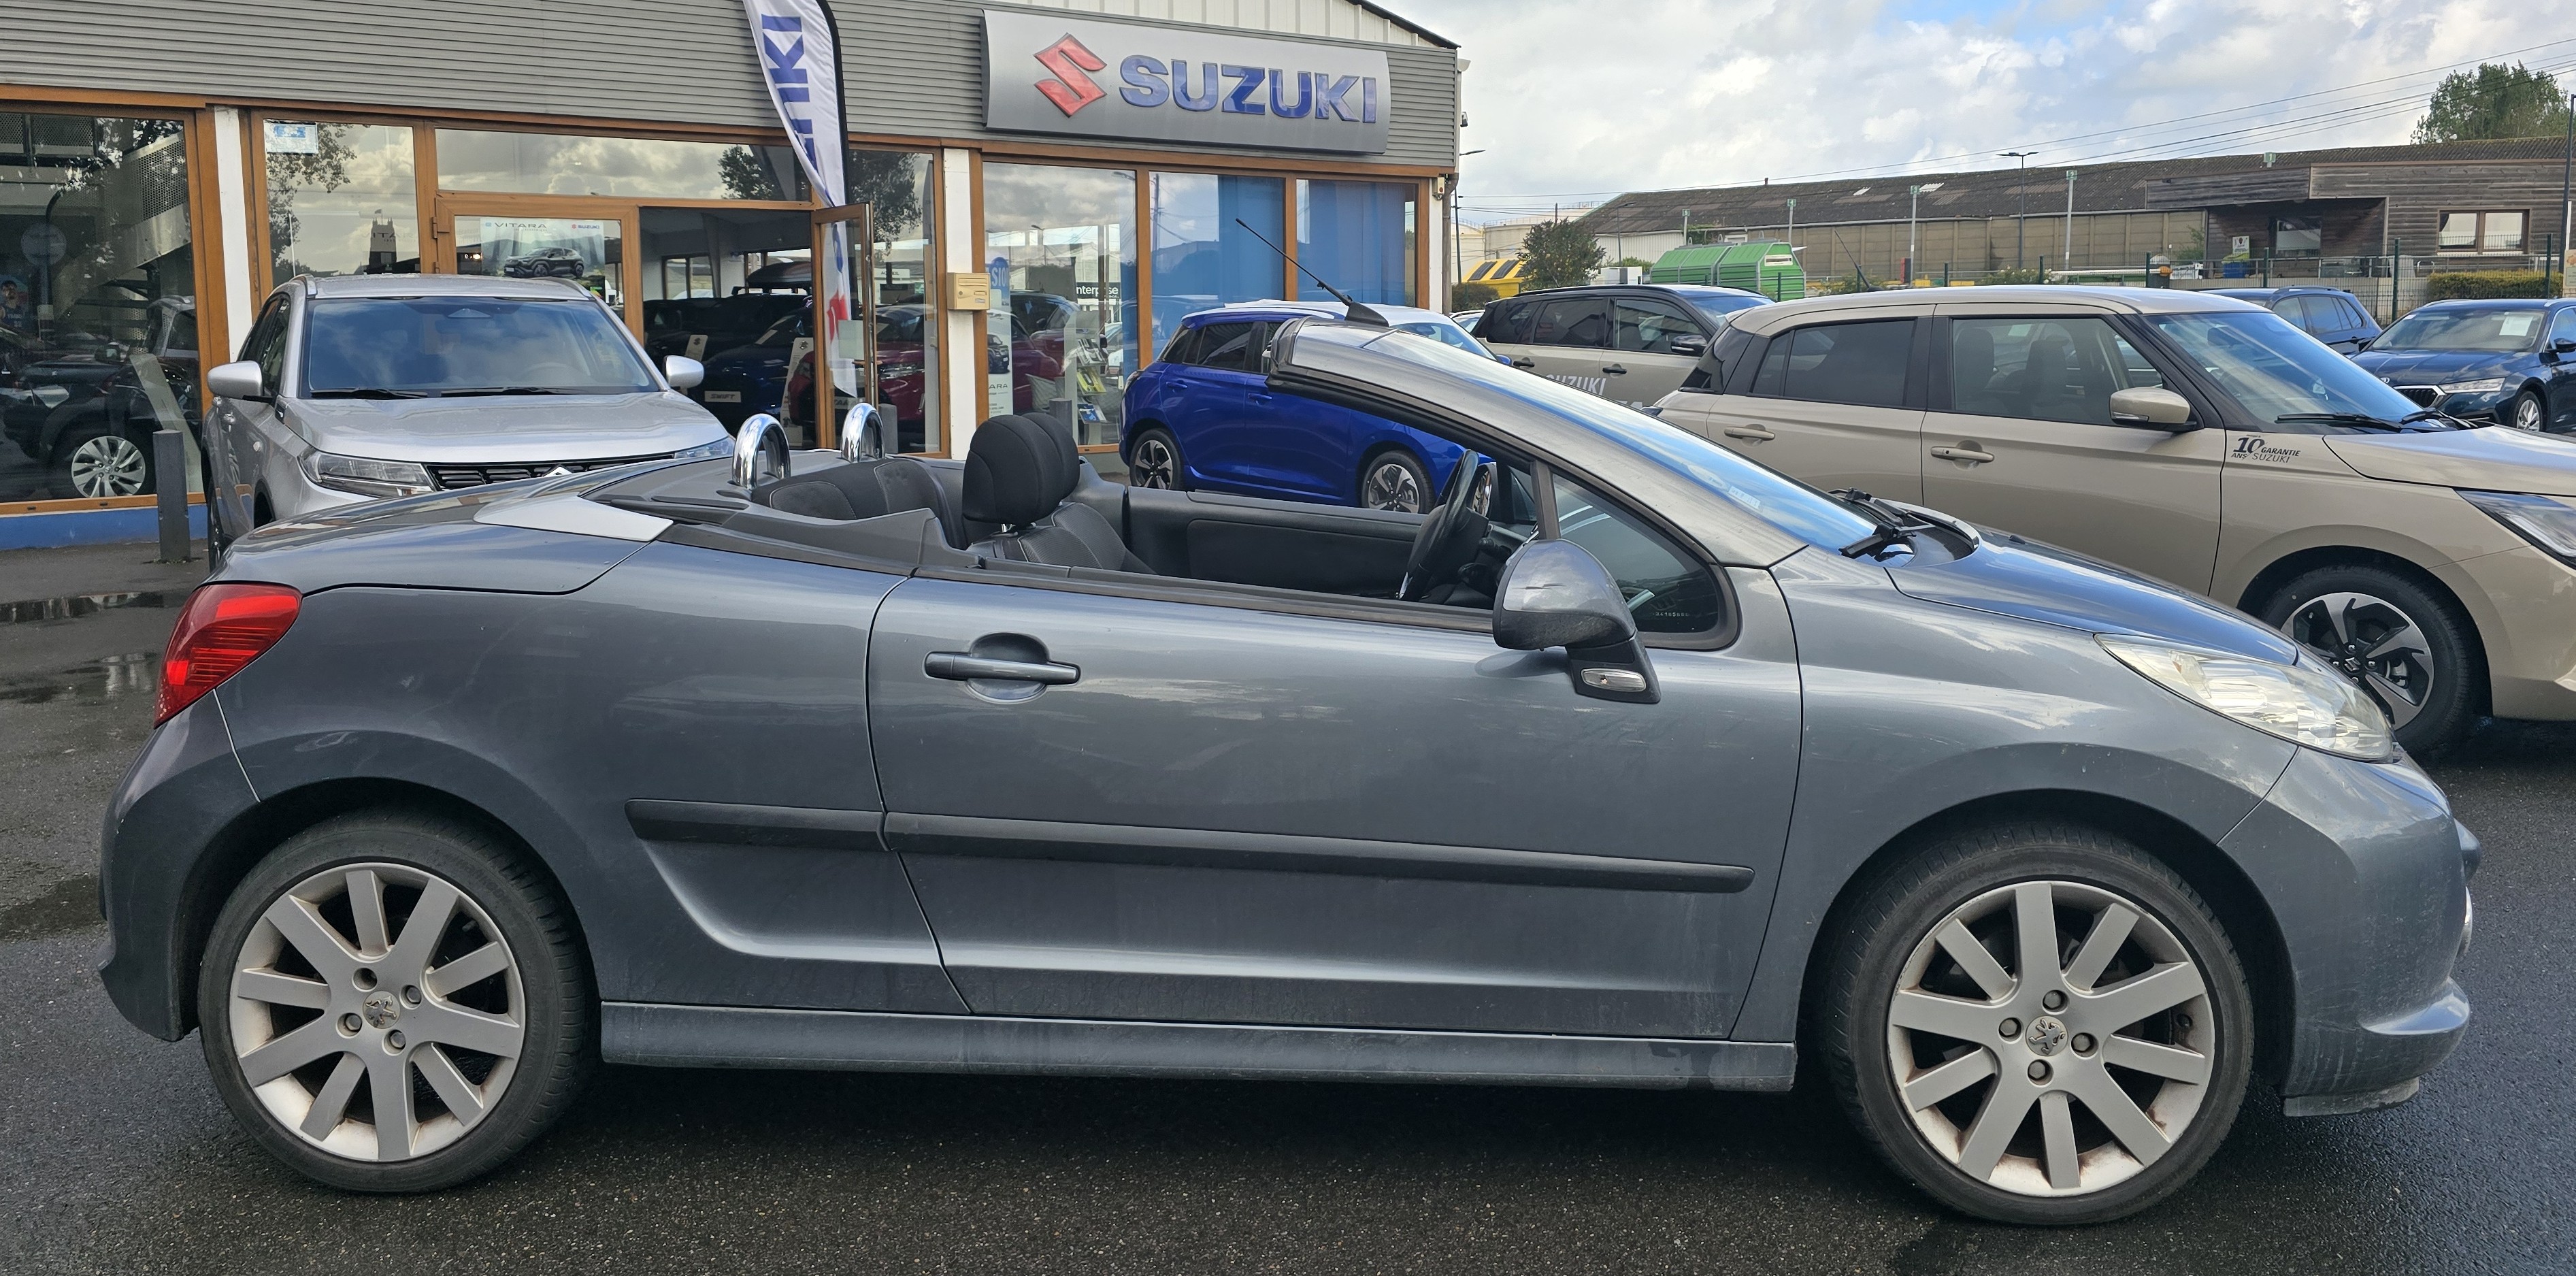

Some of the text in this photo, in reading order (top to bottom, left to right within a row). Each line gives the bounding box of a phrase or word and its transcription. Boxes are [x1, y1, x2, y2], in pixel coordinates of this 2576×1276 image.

[1119, 54, 1377, 123] SUZUKI
[2233, 438, 2266, 454] 10
[2261, 447, 2300, 457] GARANTIE
[2252, 453, 2290, 463] SUZUKI
